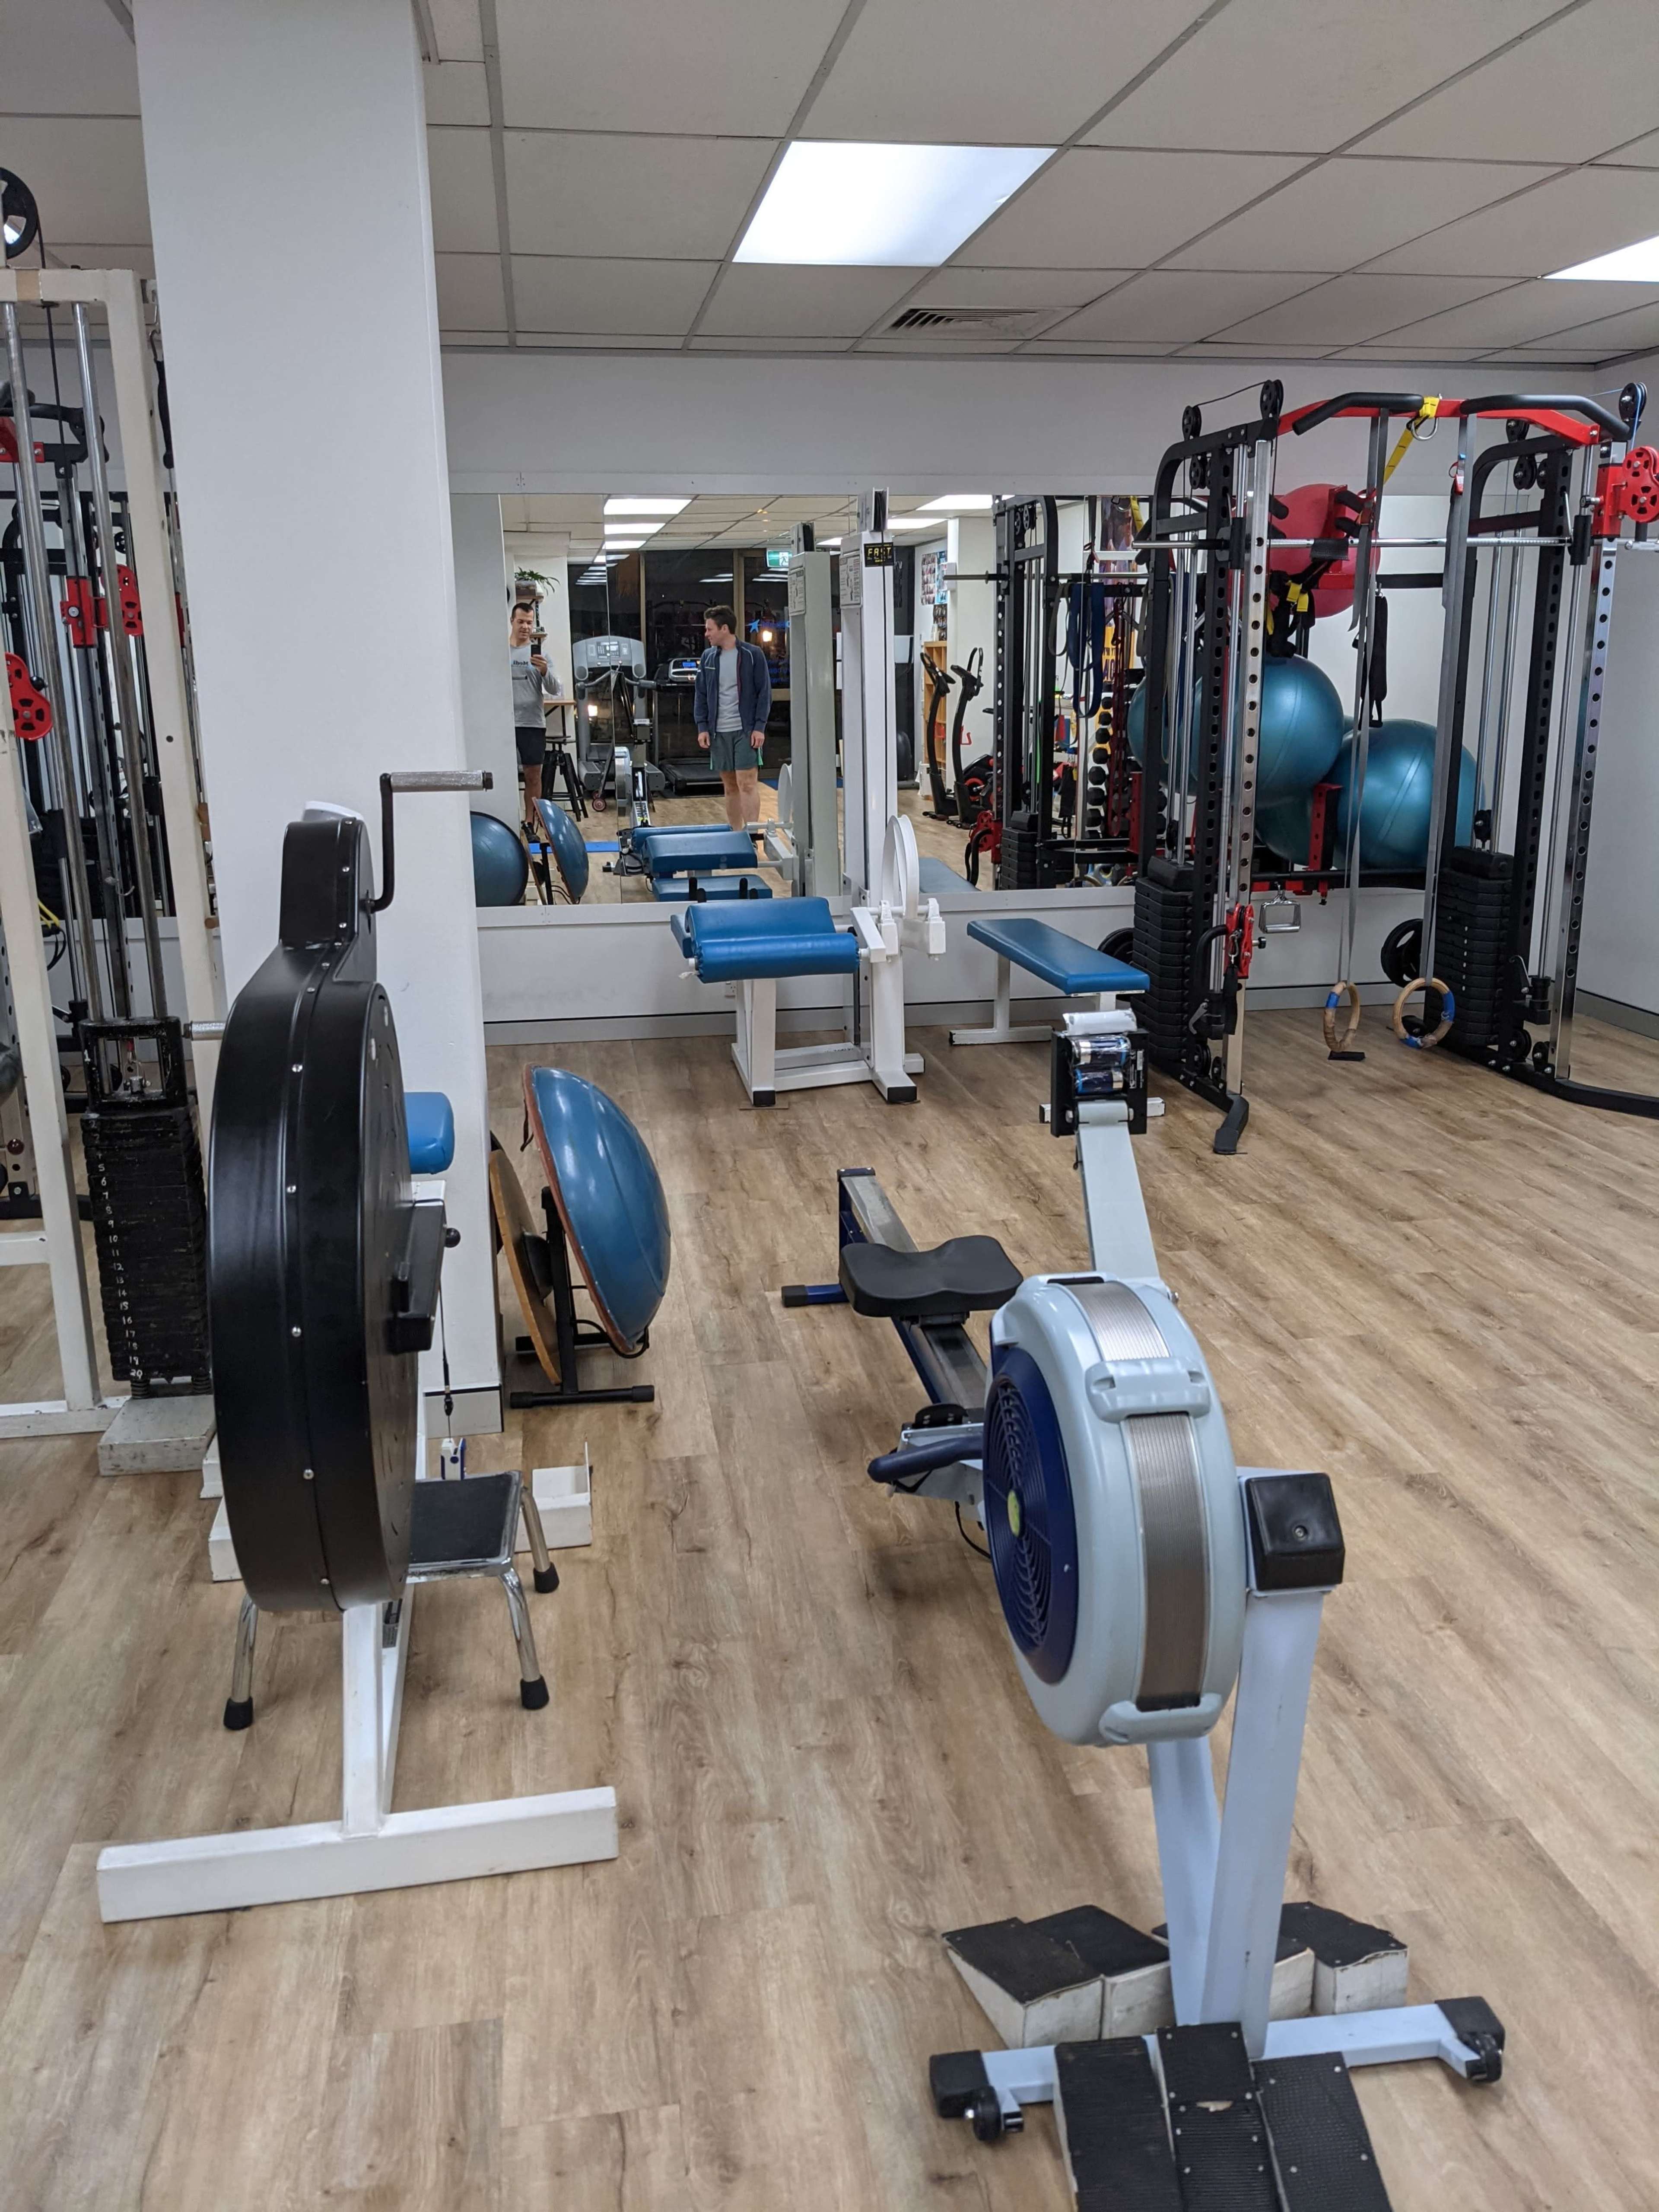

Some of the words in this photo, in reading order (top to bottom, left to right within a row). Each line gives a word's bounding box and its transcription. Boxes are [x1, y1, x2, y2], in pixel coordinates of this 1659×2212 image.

[84, 1049, 91, 1062] 1
[89, 1120, 97, 1129] 2
[98, 1163, 105, 1172] 5
[101, 1176, 107, 1186] 6
[102, 1191, 108, 1199] 7
[106, 1205, 112, 1214] 8
[108, 1220, 114, 1228] 9
[109, 1235, 118, 1243] 10
[112, 1248, 120, 1257] 11
[113, 1262, 124, 1271] 12
[116, 1276, 124, 1284] 13
[118, 1289, 127, 1297] 14
[120, 1301, 129, 1311] 15
[122, 1316, 133, 1325] 16
[125, 1329, 136, 1338] 17
[129, 1356, 139, 1365] 19
